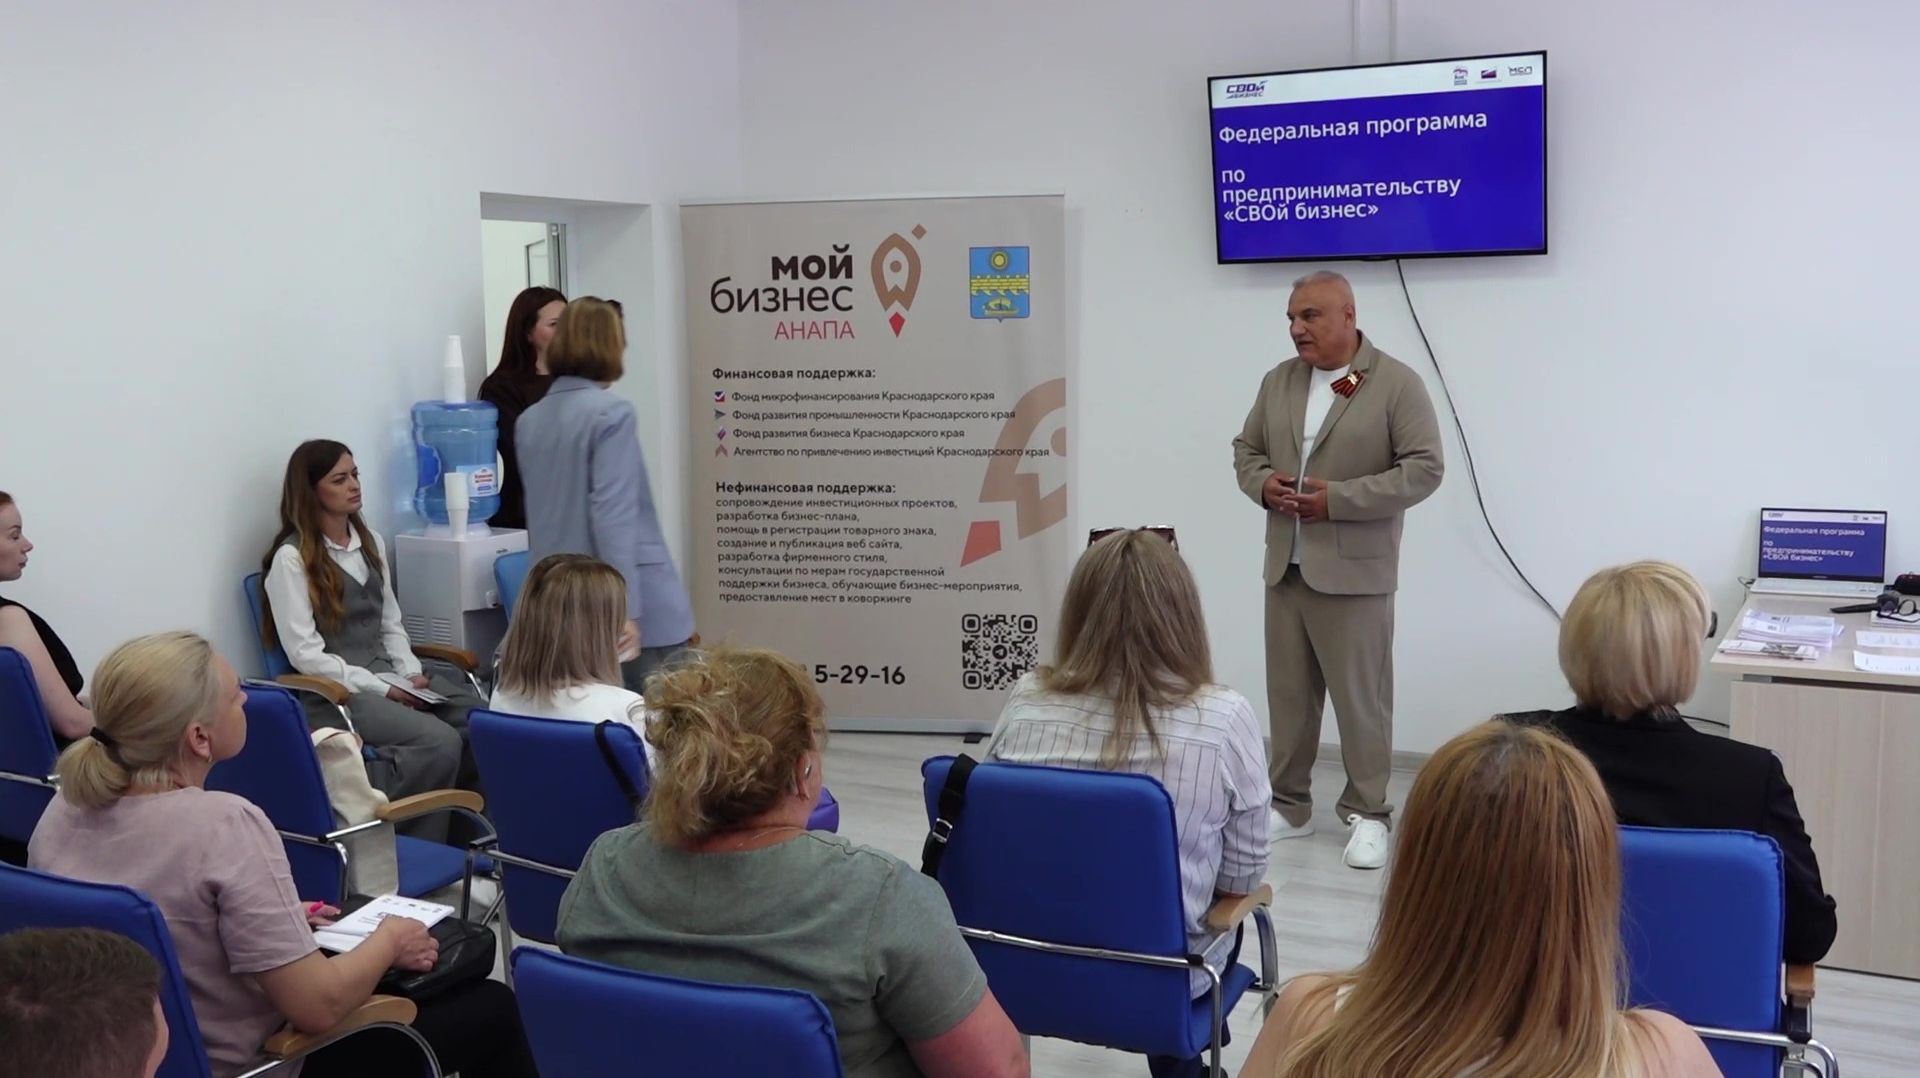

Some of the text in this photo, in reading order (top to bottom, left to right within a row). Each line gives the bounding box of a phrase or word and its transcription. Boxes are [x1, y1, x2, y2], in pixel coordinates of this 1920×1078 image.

[1219, 113, 1488, 144] Федеральная программа
[1221, 169, 1245, 183] по
[1222, 178, 1461, 205] предпринимательству
[1223, 202, 1379, 222] «СВОй бизнес»
[771, 244, 853, 280] мой
[710, 276, 853, 313] бизнес
[774, 320, 855, 340] АНАПА
[712, 368, 876, 381] Финансовая поддержка:
[732, 391, 995, 402] Фонд микрофинансирования Краснодарского края
[732, 409, 1016, 421] Фонд развития промышленности Краснодарского края
[733, 428, 965, 440] Фонд развития бизнеса Краснодарского края
[734, 446, 1050, 458] Агентство по привлечению инвестиций Краснодарского края
[716, 481, 896, 496] Нефинансовая поддержка:
[716, 499, 958, 510] сопровождение инвестиционных проектов,
[716, 511, 860, 522] разработка бизнес-плана,
[716, 525, 937, 537] помощь в регистрации товарного знака,
[1763, 526, 1865, 536] Федеральная программа
[717, 538, 903, 550] создание и публикация веб сайта,
[718, 552, 888, 563] разработка фирменного стиля,
[1762, 547, 1855, 557] предпринимательству
[718, 566, 945, 578] консультации по мерам государственной
[718, 580, 780, 590] поддержки
[832, 580, 897, 591] обучающие
[899, 580, 1023, 592] бизнес-мероприятия,
[719, 593, 912, 604] предоставление мест в коворкинге
[815, 664, 906, 685] 5-29-16
